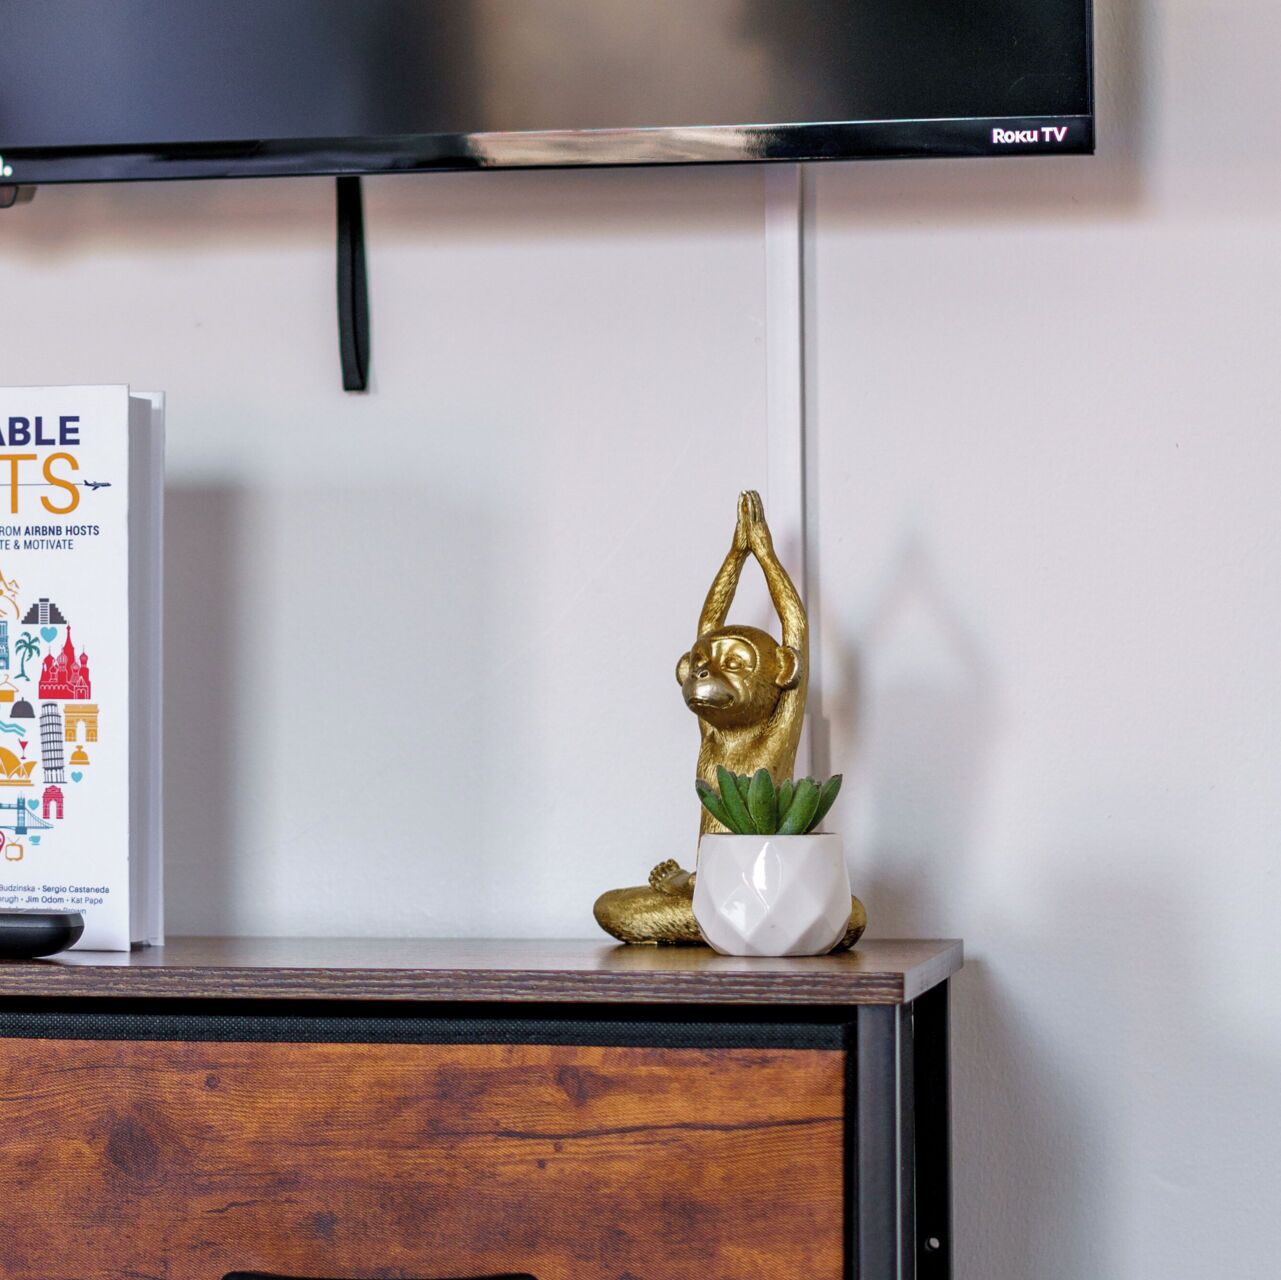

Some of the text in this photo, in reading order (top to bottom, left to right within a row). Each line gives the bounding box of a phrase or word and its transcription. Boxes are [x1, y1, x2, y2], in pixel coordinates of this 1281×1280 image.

[992, 126, 1067, 144] Roku TV
[24, 525, 62, 536] AIRBNB
[65, 525, 100, 536] HOSTS
[13, 539, 20, 550] &
[23, 538, 74, 550] MOTIVATE
[42, 885, 67, 894] Sergio
[69, 886, 110, 894] Castaneda
[25, 895, 40, 903] Jim
[41, 895, 65, 903] Odom
[71, 896, 83, 904] Kat
